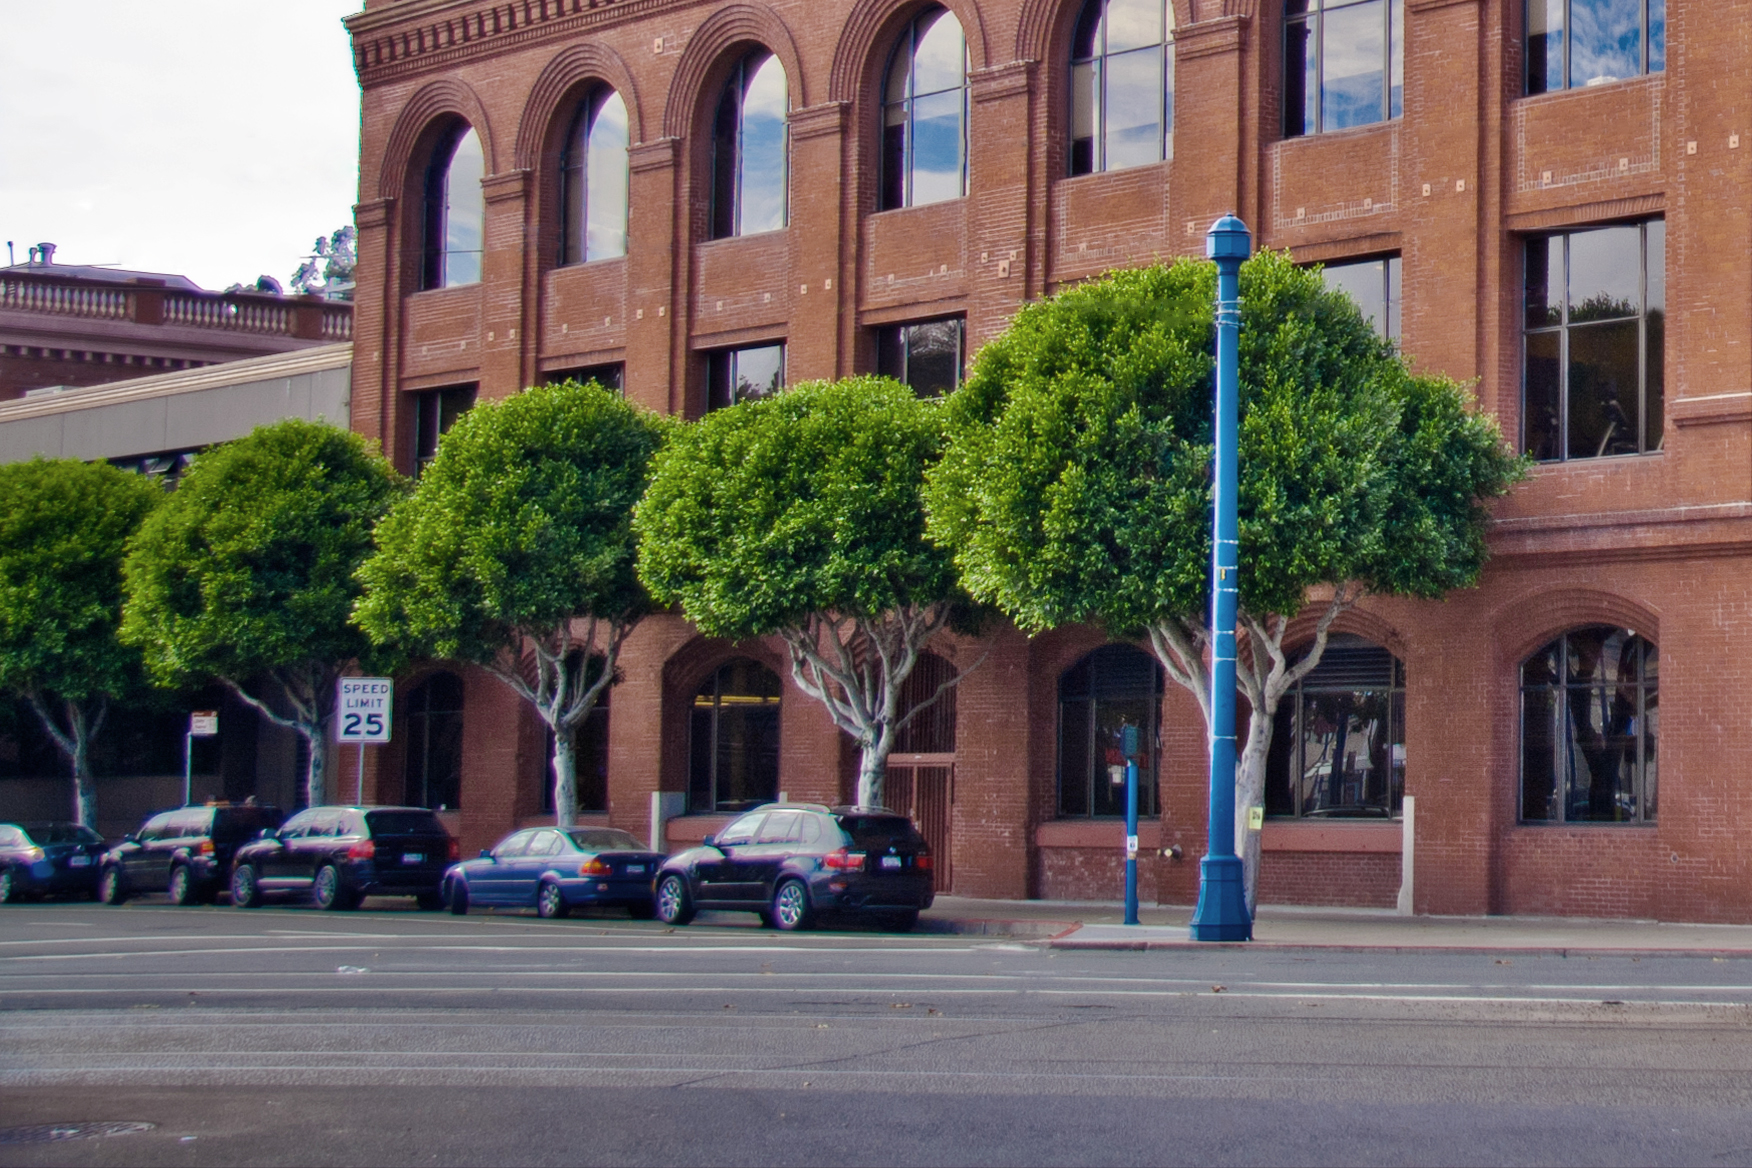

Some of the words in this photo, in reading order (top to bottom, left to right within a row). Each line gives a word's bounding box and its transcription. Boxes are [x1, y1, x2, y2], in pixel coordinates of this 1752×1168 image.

[344, 684, 389, 694] SPEED
[347, 698, 383, 708] LIMIT
[344, 712, 384, 736] 25
